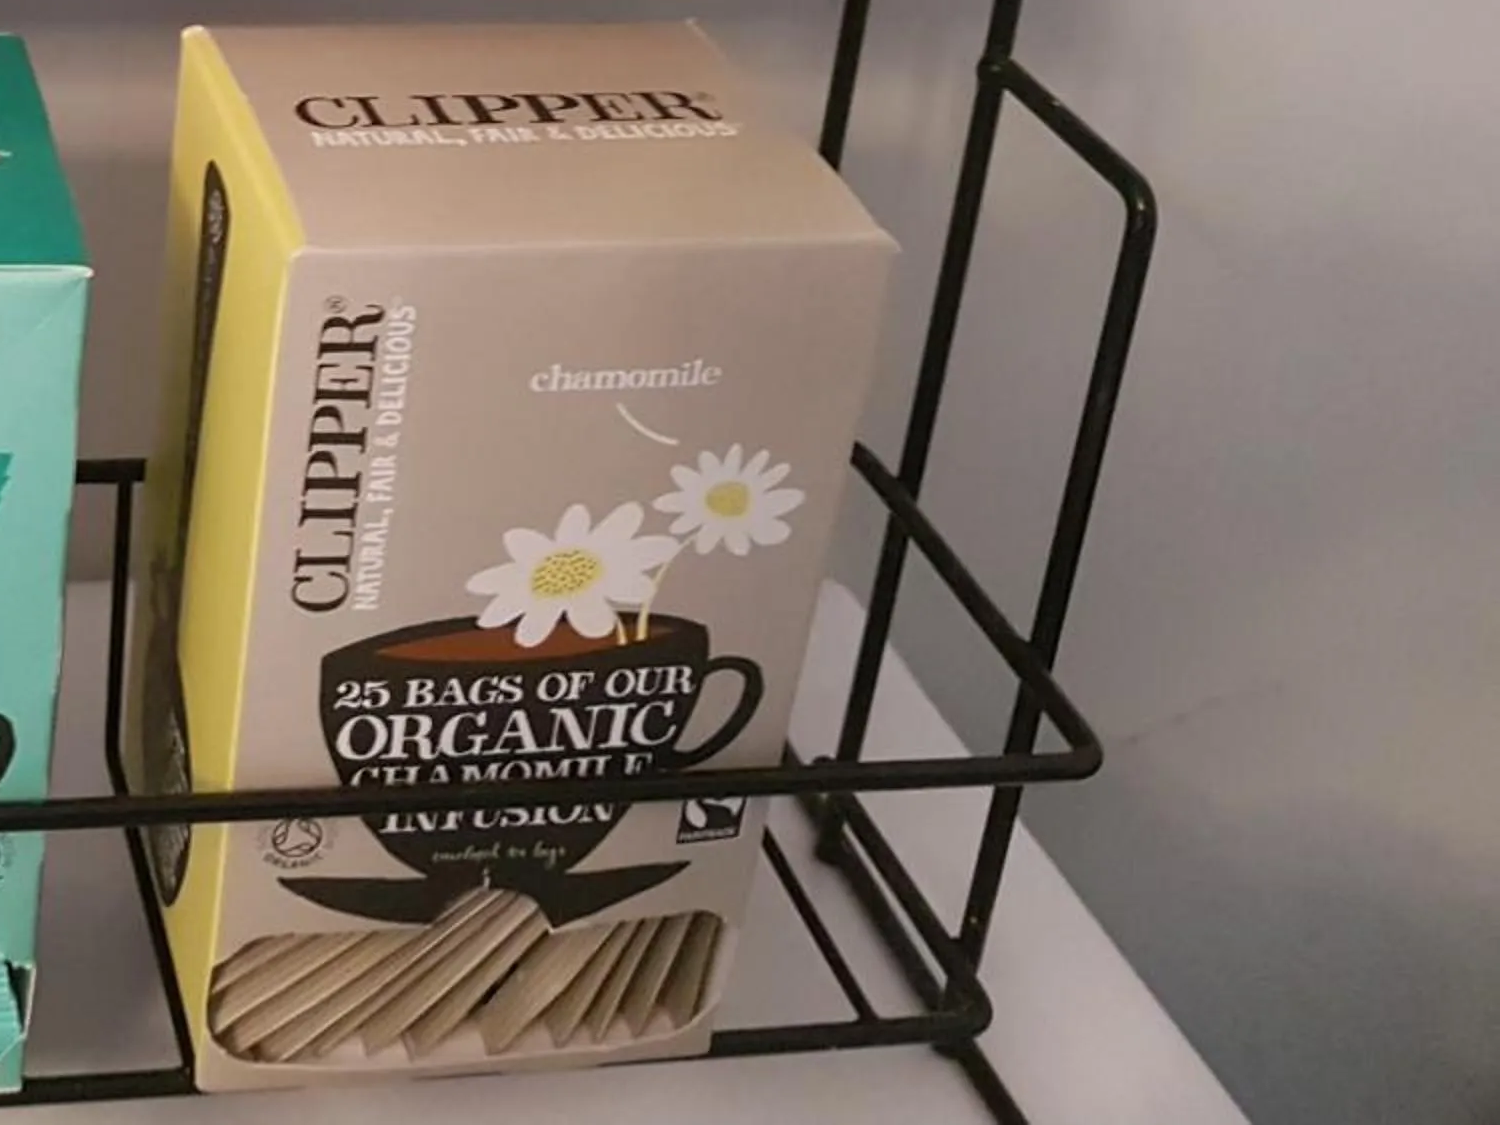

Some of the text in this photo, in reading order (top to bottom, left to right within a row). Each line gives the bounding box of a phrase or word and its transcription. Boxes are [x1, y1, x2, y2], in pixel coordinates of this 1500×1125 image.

[295, 91, 724, 129] CLIPPER
[311, 120, 738, 148] NATURAL, FAIR & DELICIOUS
[529, 357, 722, 393] chamomile
[352, 304, 417, 611] NATURAL, FAIR & DELICIOUS
[334, 665, 699, 711] 25 BAGS OF OUR
[334, 699, 678, 761] ORGANIC
